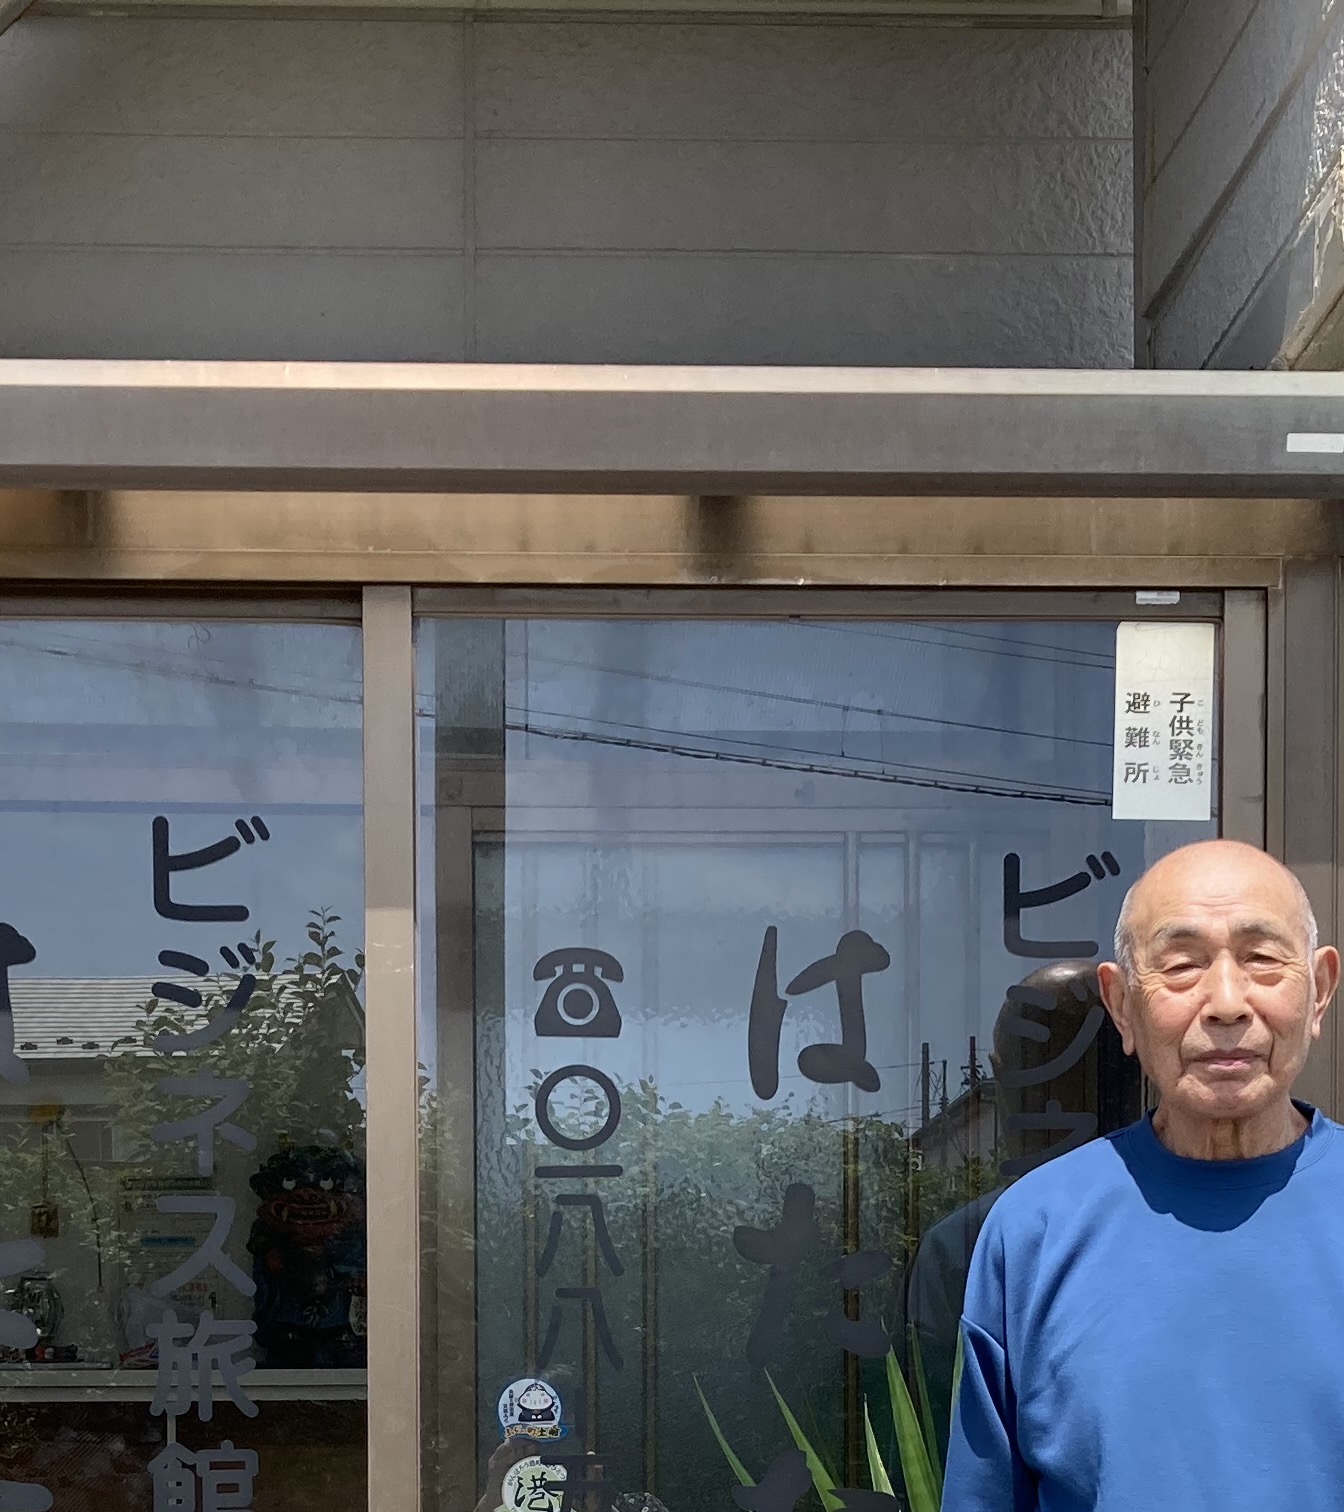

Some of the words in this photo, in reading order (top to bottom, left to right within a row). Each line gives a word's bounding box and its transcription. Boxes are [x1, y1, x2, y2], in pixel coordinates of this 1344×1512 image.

[1123, 692, 1150, 784] 避難所
[1168, 692, 1195, 784] 子供緊急
